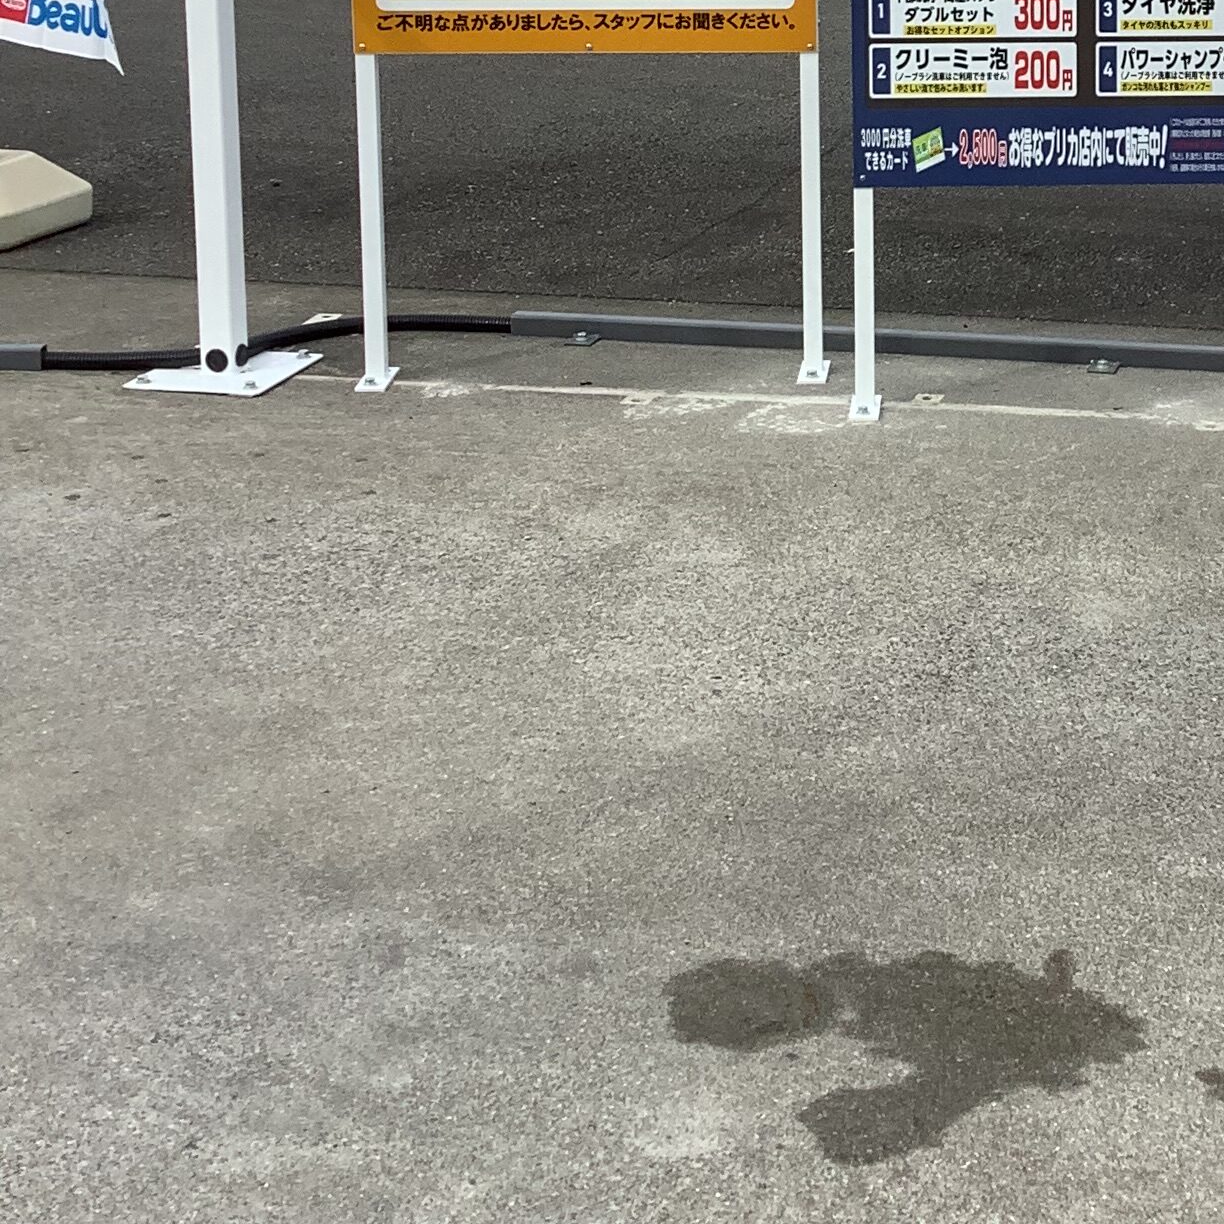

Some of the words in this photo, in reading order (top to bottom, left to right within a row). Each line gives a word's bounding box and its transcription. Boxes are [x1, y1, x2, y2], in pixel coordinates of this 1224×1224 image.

[877, 2, 885, 19] 1
[904, 6, 995, 23] ダブルセット
[377, 13, 796, 32] ご不明な点がありましたら、スタッフにお聞きください。
[876, 63, 887, 80] 2
[894, 47, 1009, 71] クリーミー泡
[1013, 50, 1073, 92] 200円
[864, 151, 909, 171] できるカード
